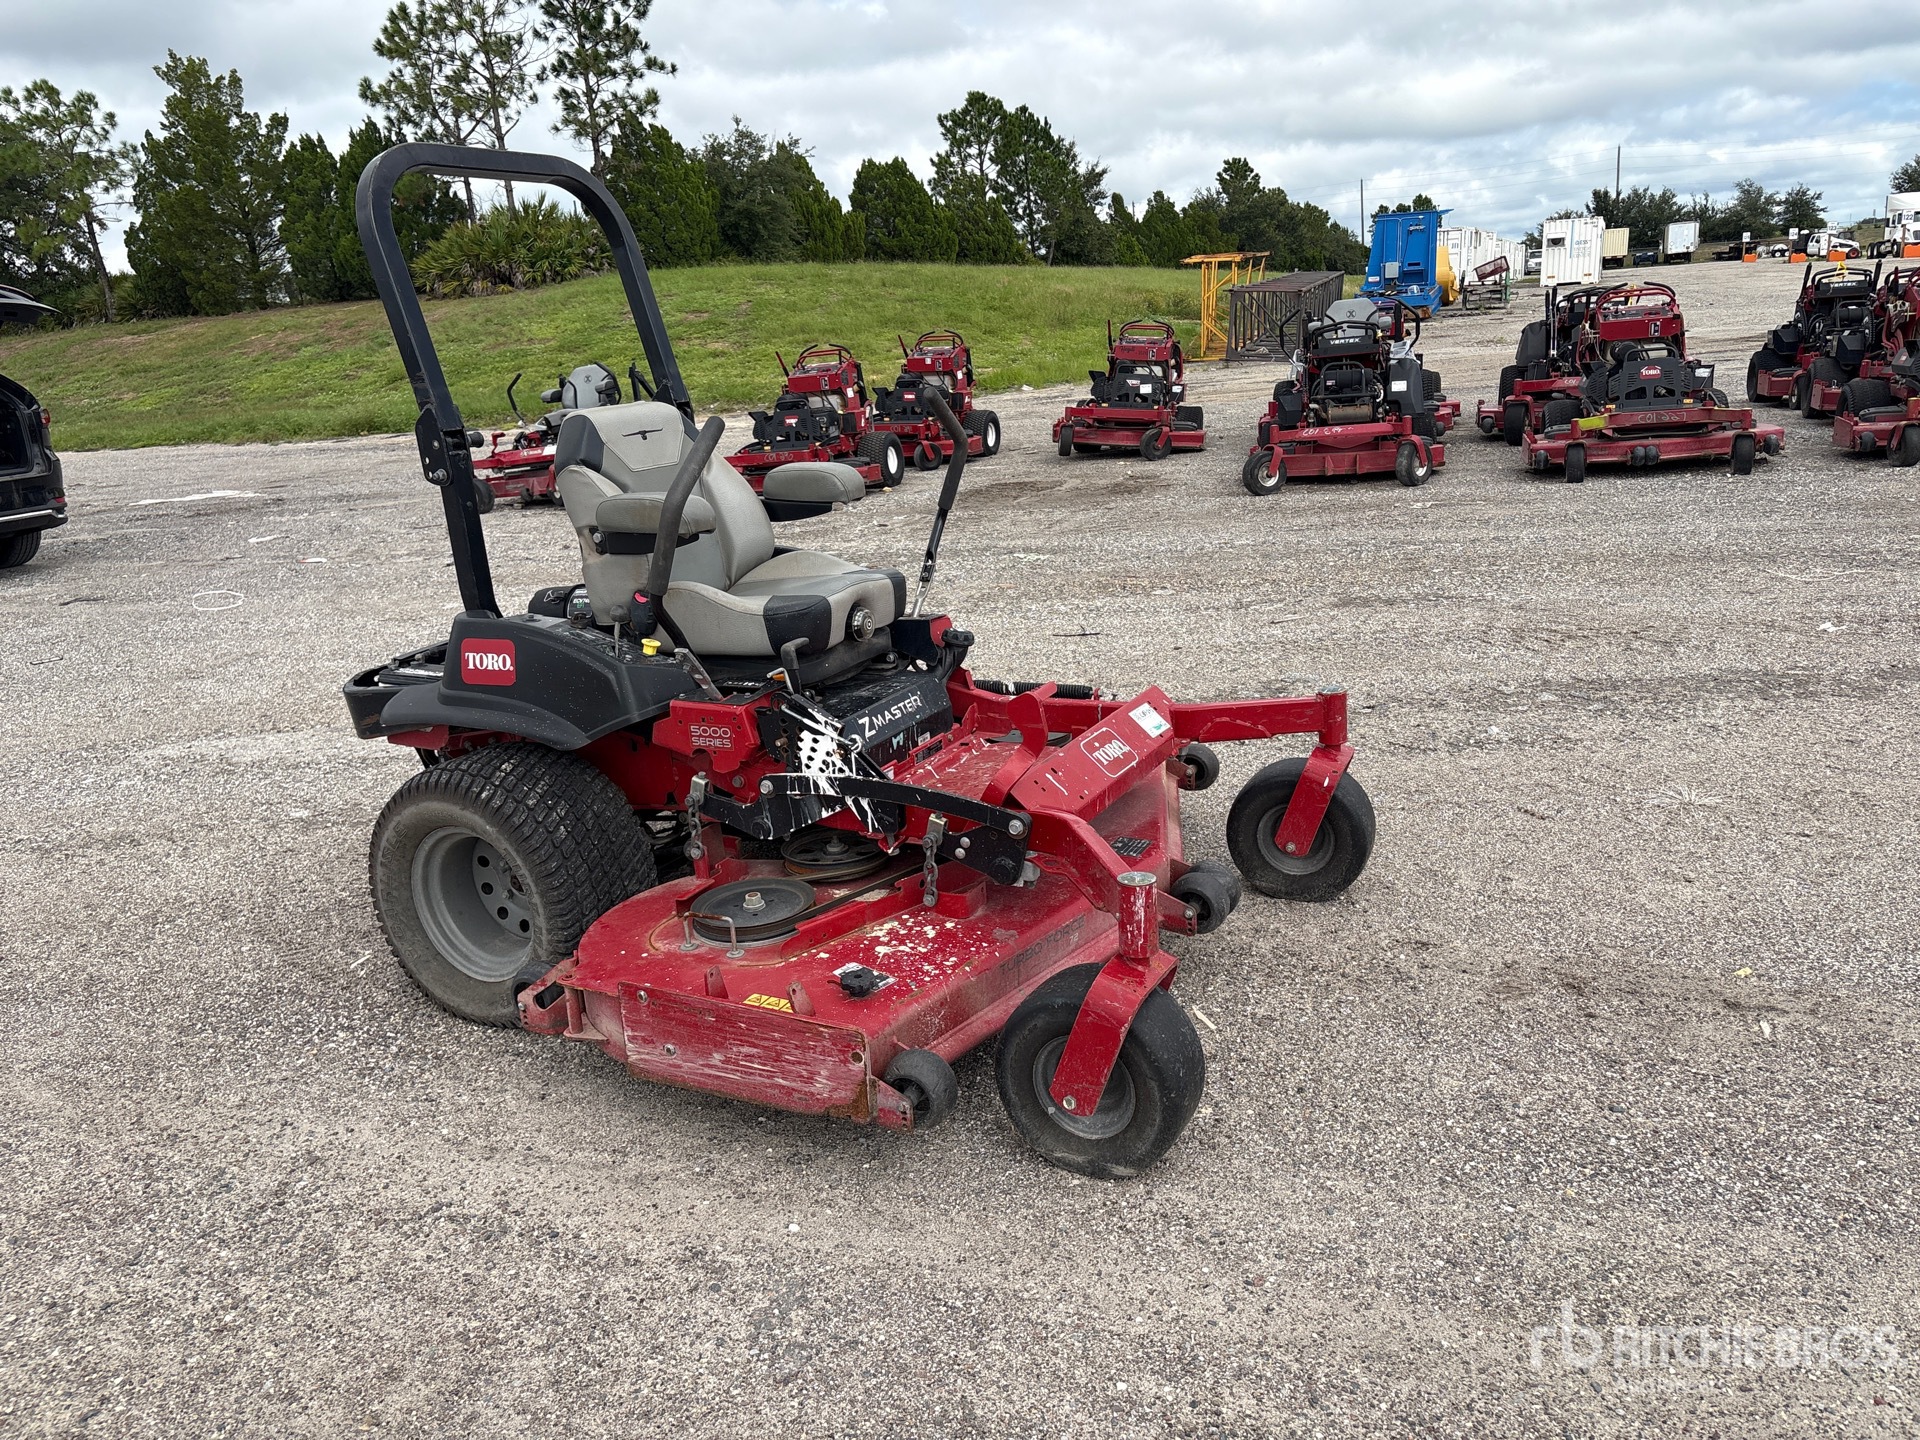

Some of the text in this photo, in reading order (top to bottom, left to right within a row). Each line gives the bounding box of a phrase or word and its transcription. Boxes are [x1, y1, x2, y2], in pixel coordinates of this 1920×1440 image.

[690, 725, 731, 737] 5000
[691, 737, 732, 748] SERIES
[1000, 912, 1086, 975] TURBO FORCE
